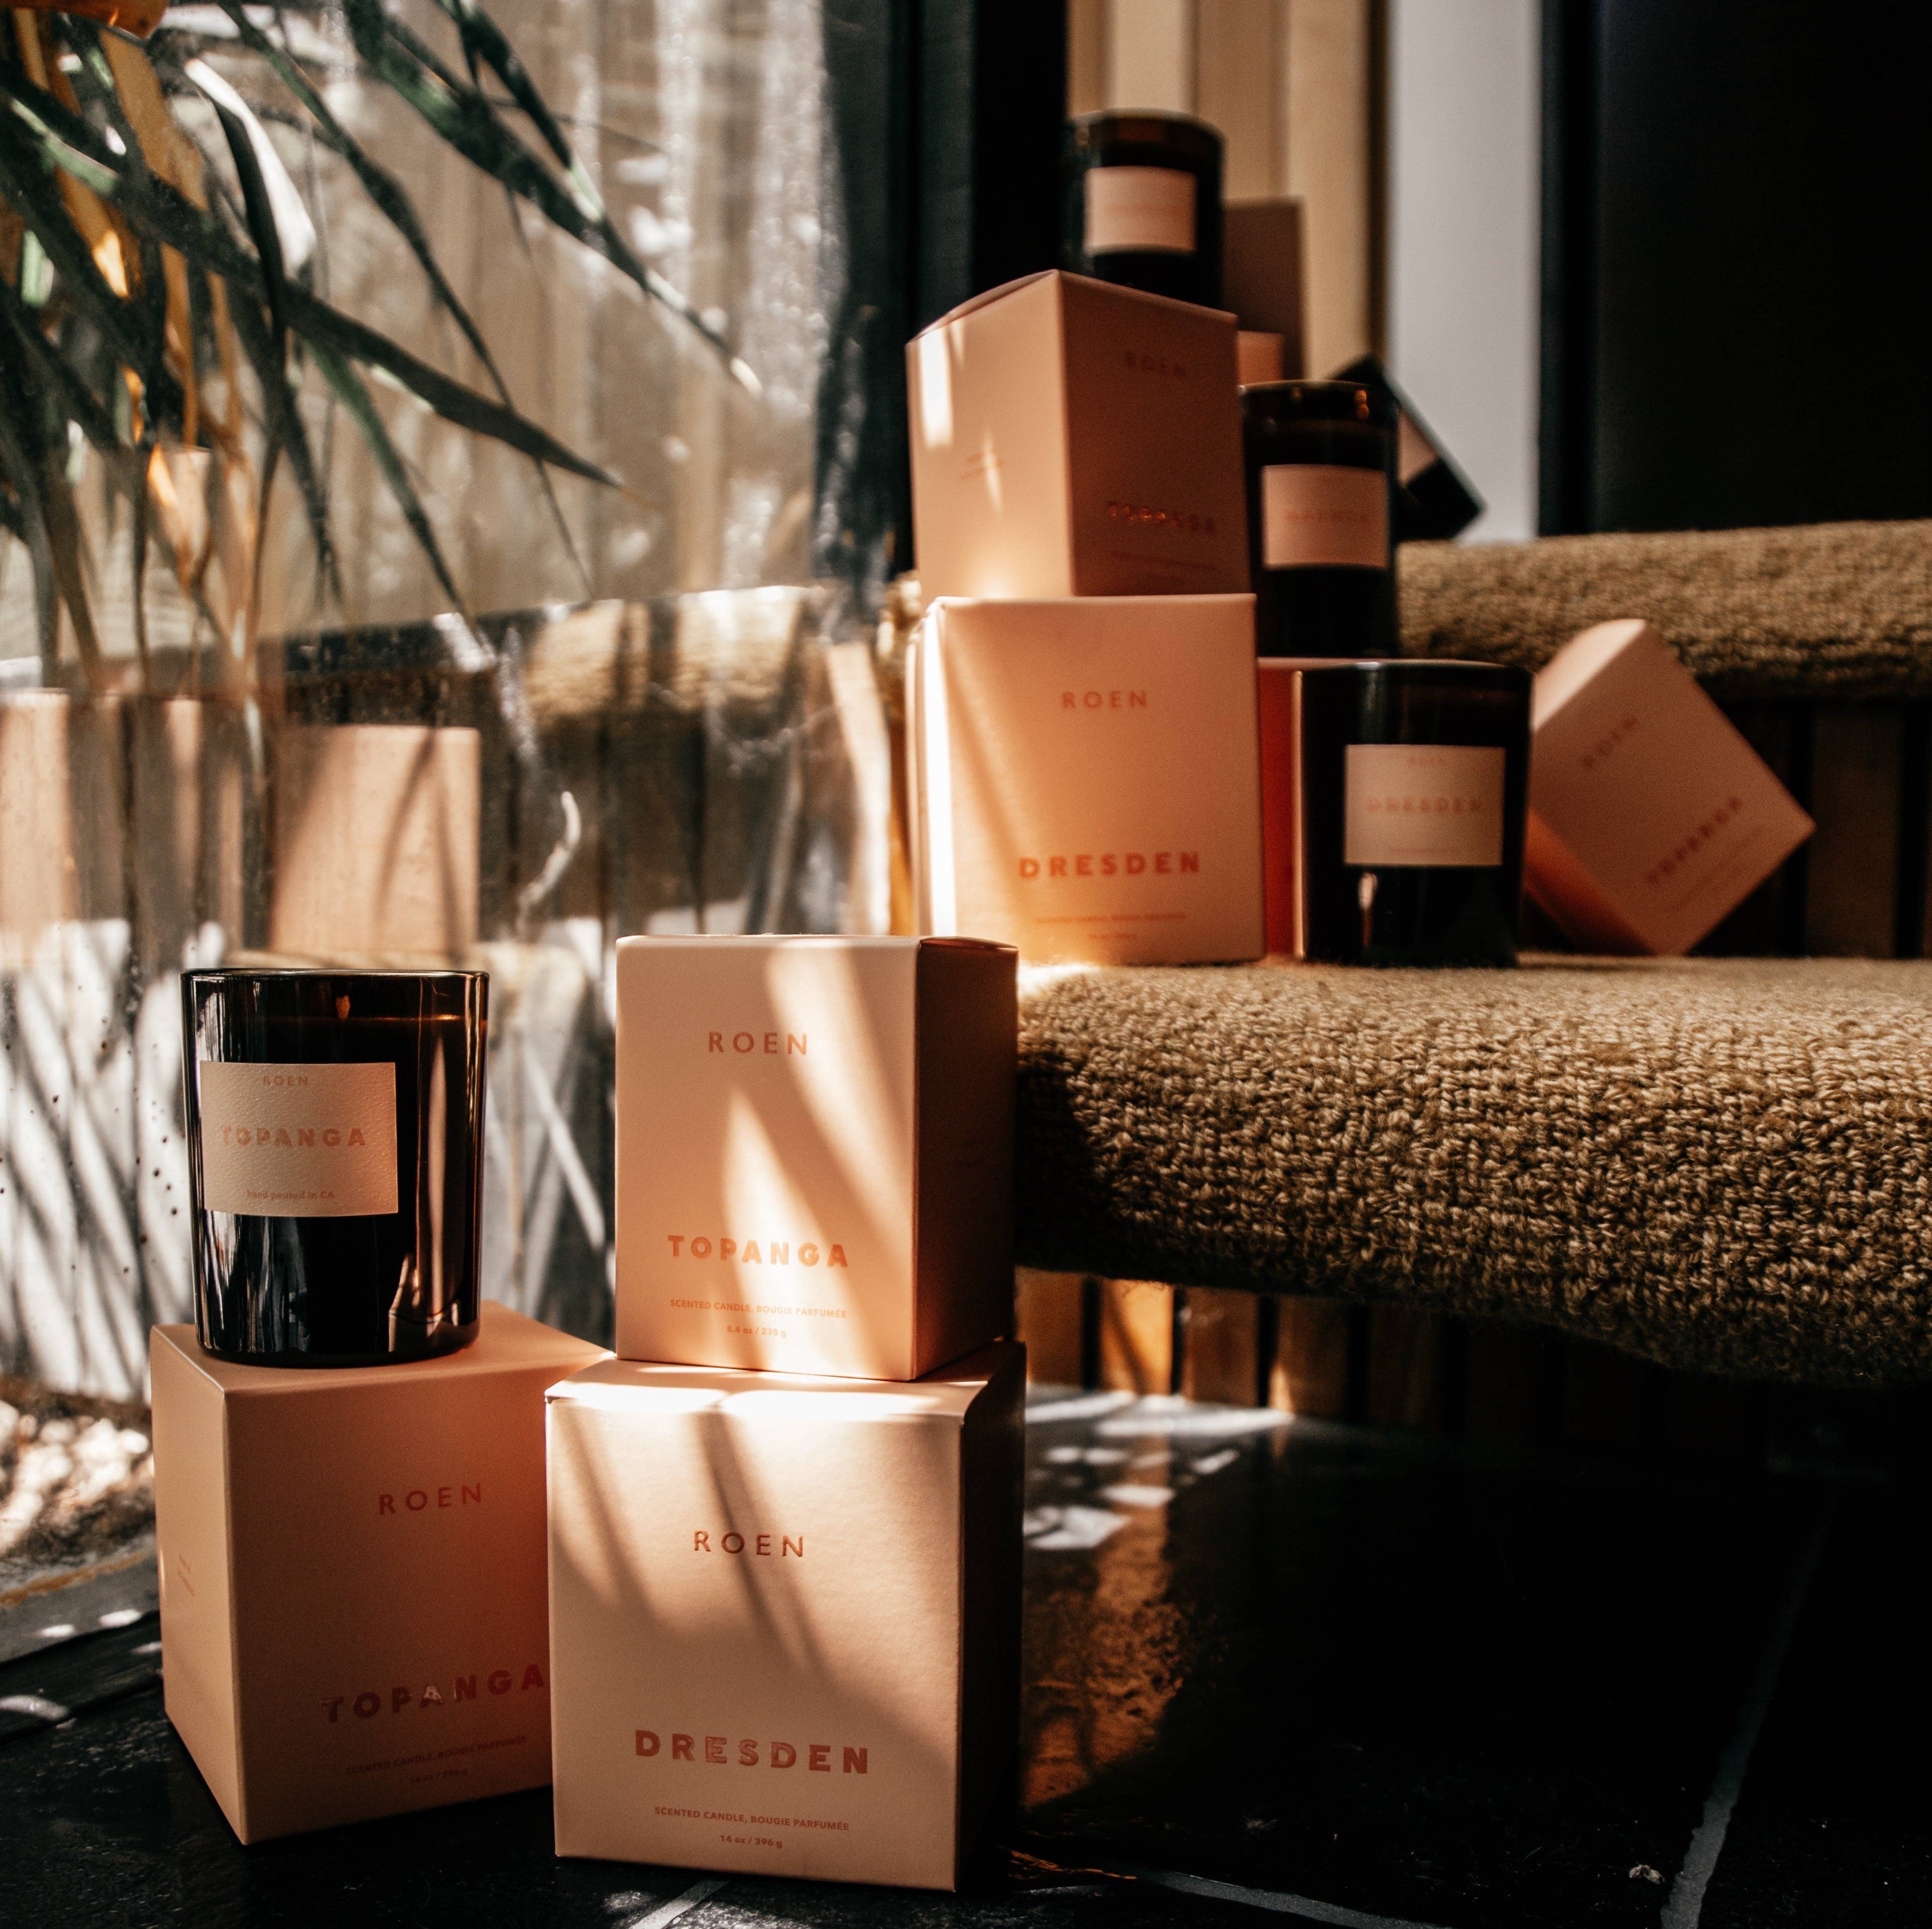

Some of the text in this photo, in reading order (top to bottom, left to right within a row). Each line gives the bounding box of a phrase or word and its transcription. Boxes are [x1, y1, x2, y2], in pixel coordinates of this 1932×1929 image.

[1061, 690, 1148, 709] ROEN
[1019, 851, 1200, 879] DRESDEN
[708, 1031, 808, 1056] ROEN
[262, 1075, 309, 1087] ROEN
[220, 1124, 366, 1148] TOPANGA
[307, 1190, 317, 1199] in
[320, 1191, 335, 1199] CA
[668, 1234, 849, 1268] TOPANGA
[670, 1299, 847, 1319] SCENTED CANDLE, BOUGIE PARFUMÉE
[727, 1325, 741, 1333] 8.4
[761, 1327, 778, 1336] 238
[780, 1330, 787, 1338] g
[378, 1482, 482, 1515] ROEN
[693, 1530, 805, 1558] ROEN
[321, 1663, 545, 1723] TOPANGA
[635, 1729, 869, 1775] DRESDEN
[654, 1806, 850, 1831] SCENTED CANDLE, BOUGIE PARFUMÉE
[720, 1834, 733, 1842] 14
[755, 1837, 774, 1846] 396
[776, 1840, 783, 1849] g
